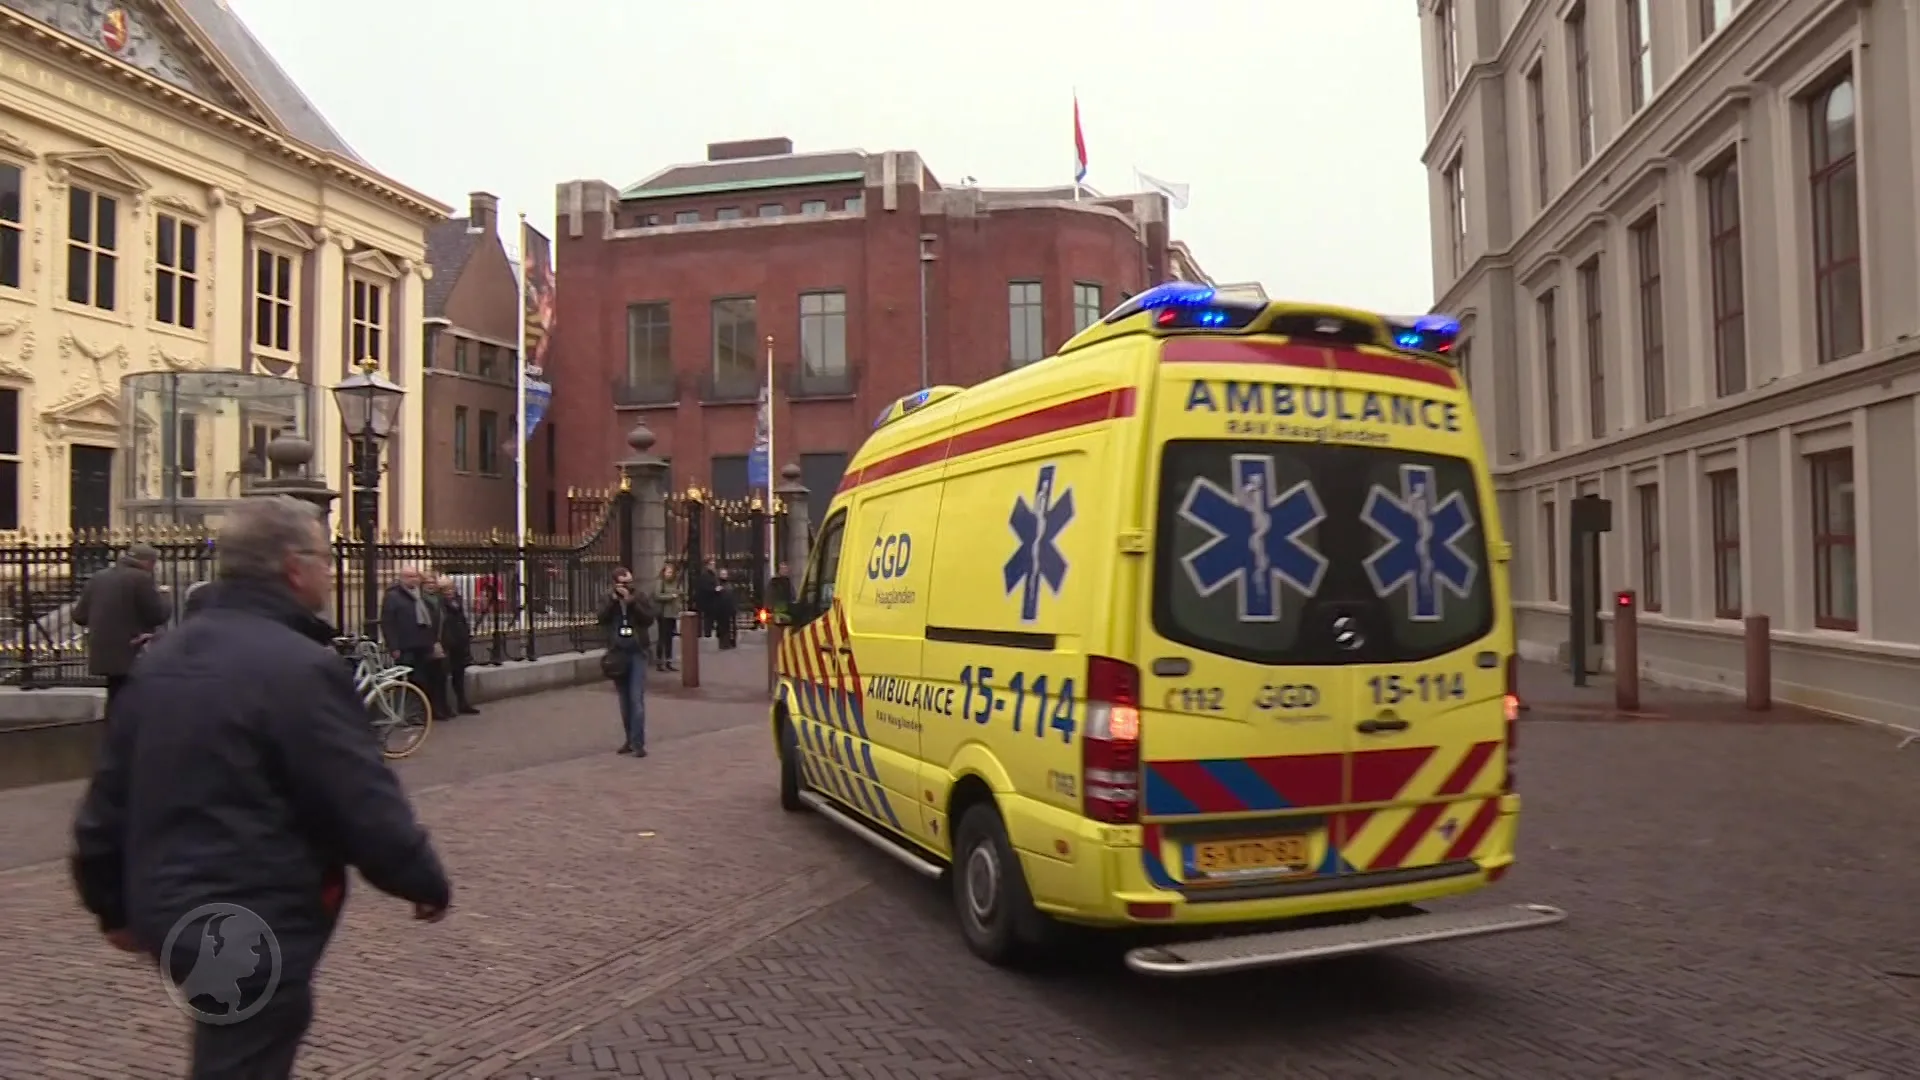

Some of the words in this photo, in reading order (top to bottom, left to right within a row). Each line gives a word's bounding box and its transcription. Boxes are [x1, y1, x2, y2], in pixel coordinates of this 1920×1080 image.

[1184, 379, 1460, 432] AMBULANCE
[868, 533, 911, 579] GGD
[867, 675, 955, 715] AMBULANCE
[960, 665, 1076, 744] 15-114
[1181, 687, 1225, 711] 112
[1253, 684, 1321, 709] GGD
[1367, 672, 1466, 705] 15-114
